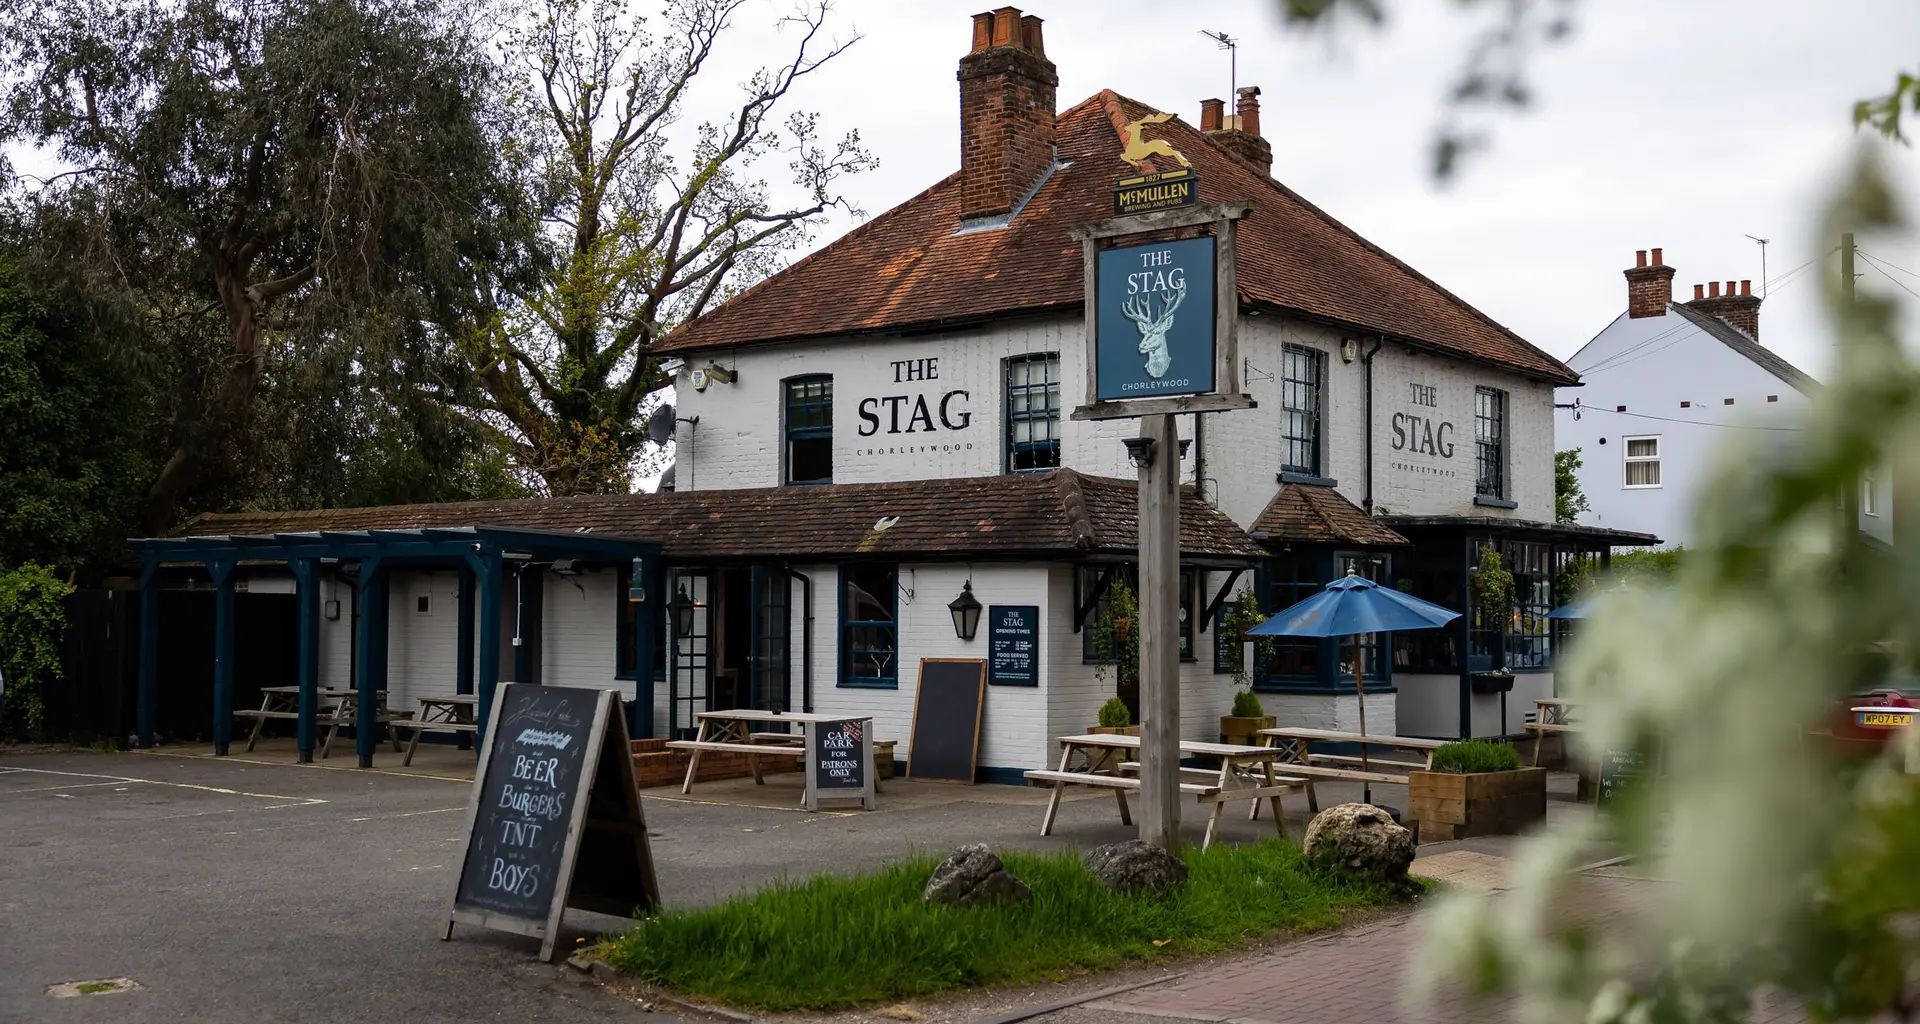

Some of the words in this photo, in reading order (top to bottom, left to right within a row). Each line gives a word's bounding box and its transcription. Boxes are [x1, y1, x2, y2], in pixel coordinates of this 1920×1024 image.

[1124, 202, 1152, 212] BREWING
[1140, 250, 1172, 268] THE
[1128, 268, 1185, 294] STAG
[890, 357, 938, 382] THE
[1122, 378, 1189, 390] CHORLEYWOOD
[1410, 382, 1437, 408] THE
[858, 390, 972, 436] STAG
[1392, 412, 1454, 458] STAG
[857, 443, 972, 456] CHORLEYWOOD
[1003, 618, 1024, 626] STAG
[824, 740, 854, 748] PARK
[828, 732, 850, 740] CAR
[513, 755, 558, 788] BEER
[822, 760, 858, 769] PATRONS
[502, 820, 542, 848] TNT
[488, 858, 540, 898] BOYS
